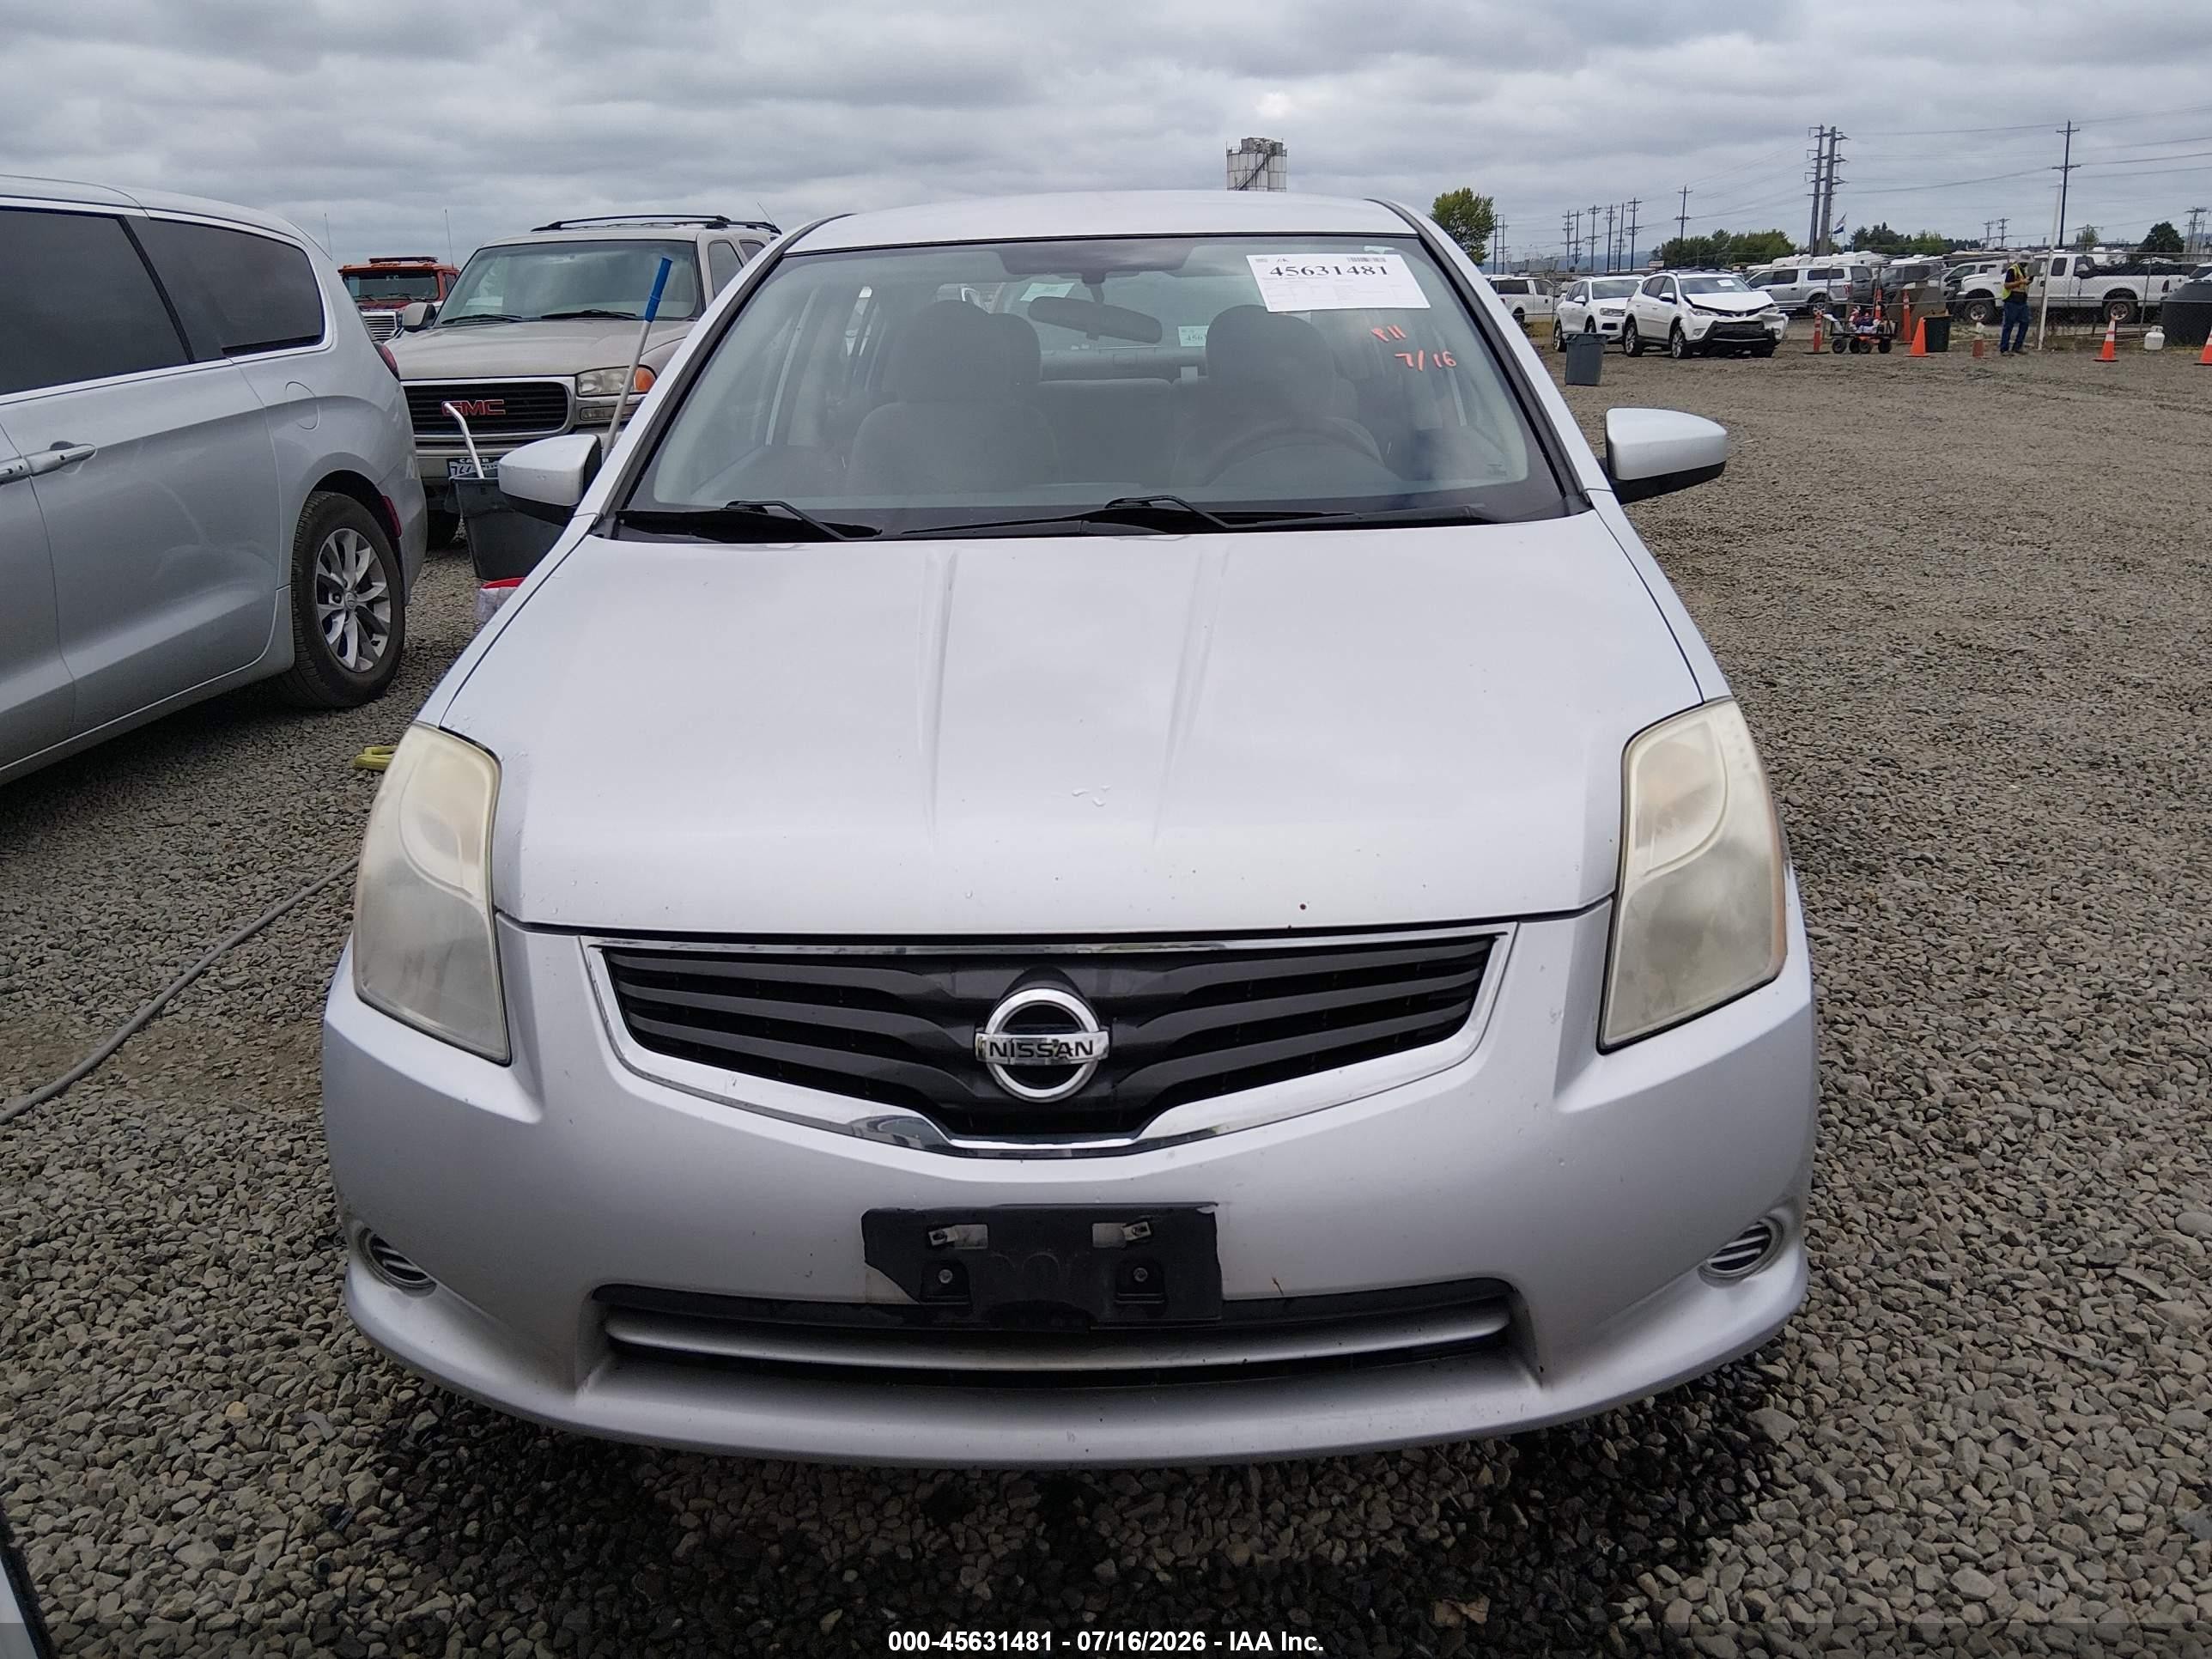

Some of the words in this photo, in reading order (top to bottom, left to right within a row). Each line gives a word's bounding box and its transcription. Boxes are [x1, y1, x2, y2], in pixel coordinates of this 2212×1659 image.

[1269, 265, 1389, 276] 45631481
[441, 399, 507, 416] GMC
[988, 1040, 1094, 1058] NISSAN
